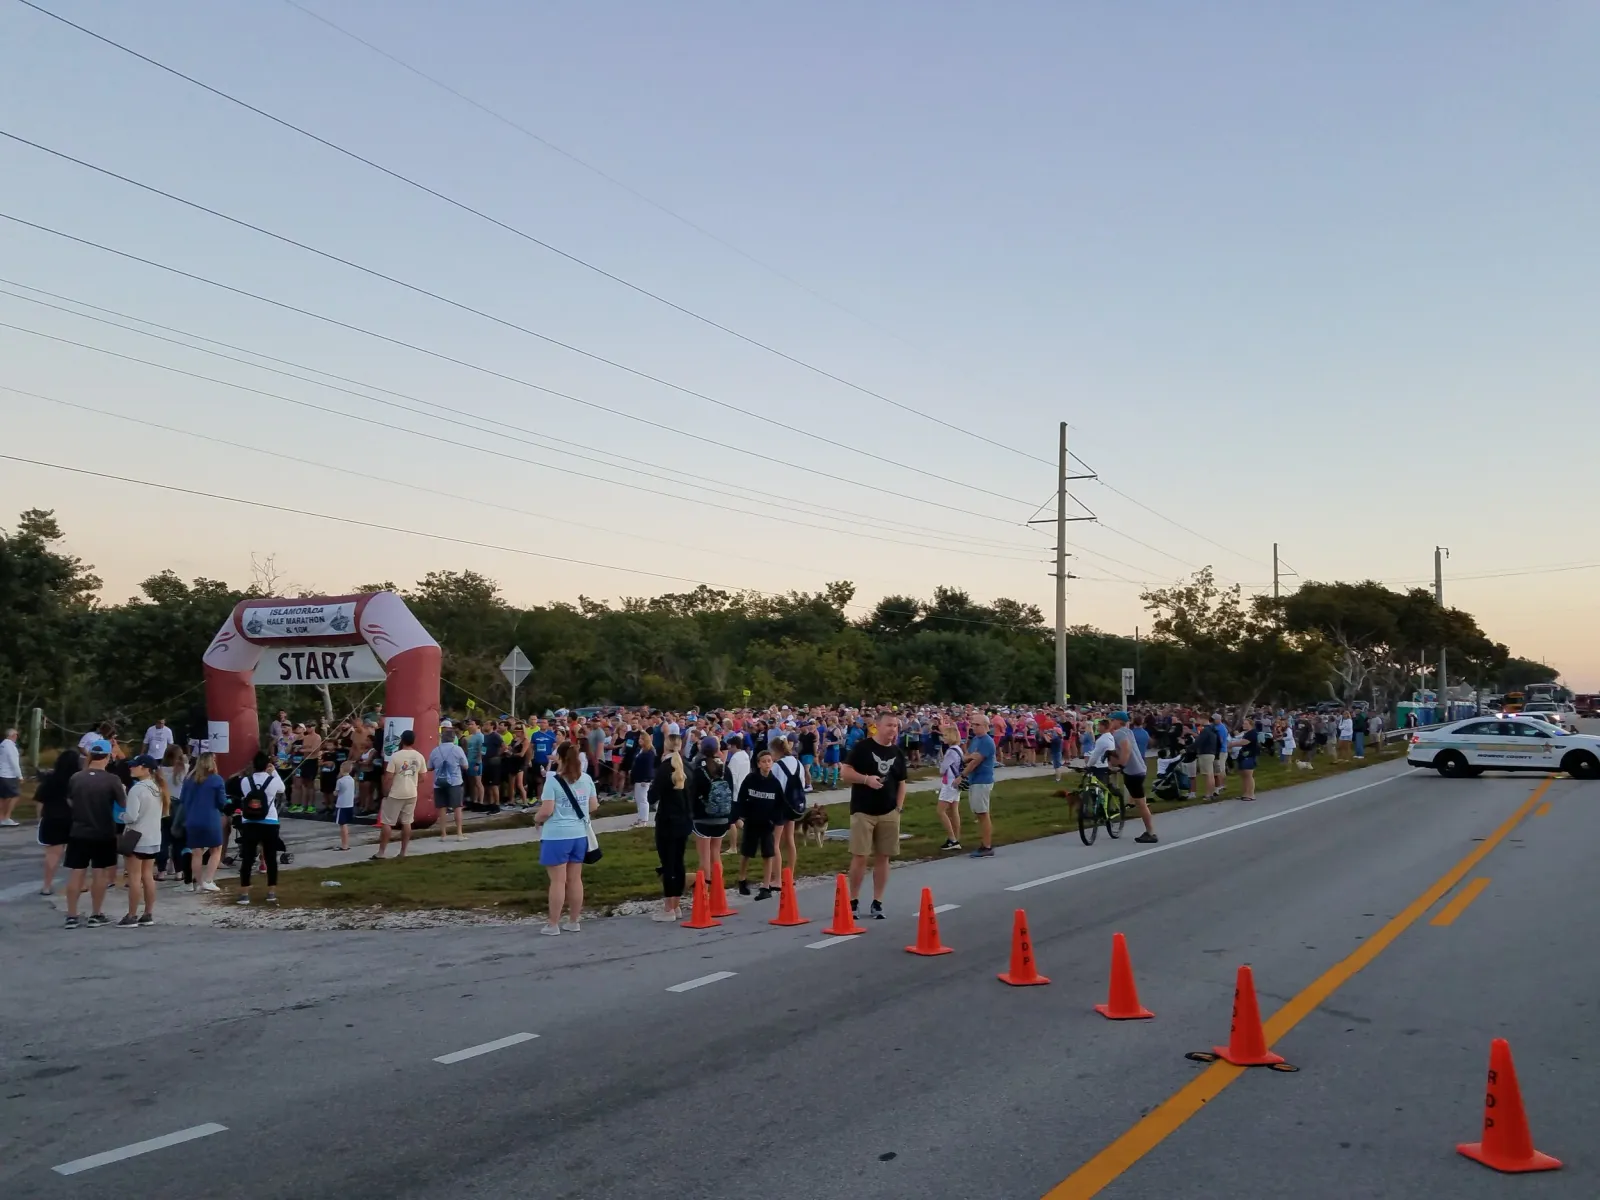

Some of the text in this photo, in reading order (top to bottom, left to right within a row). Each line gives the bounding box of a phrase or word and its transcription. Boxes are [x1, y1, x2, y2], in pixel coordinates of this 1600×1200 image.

[286, 616, 325, 625] MARATHON
[277, 651, 355, 680] START
[1484, 1069, 1498, 1131] RDP
